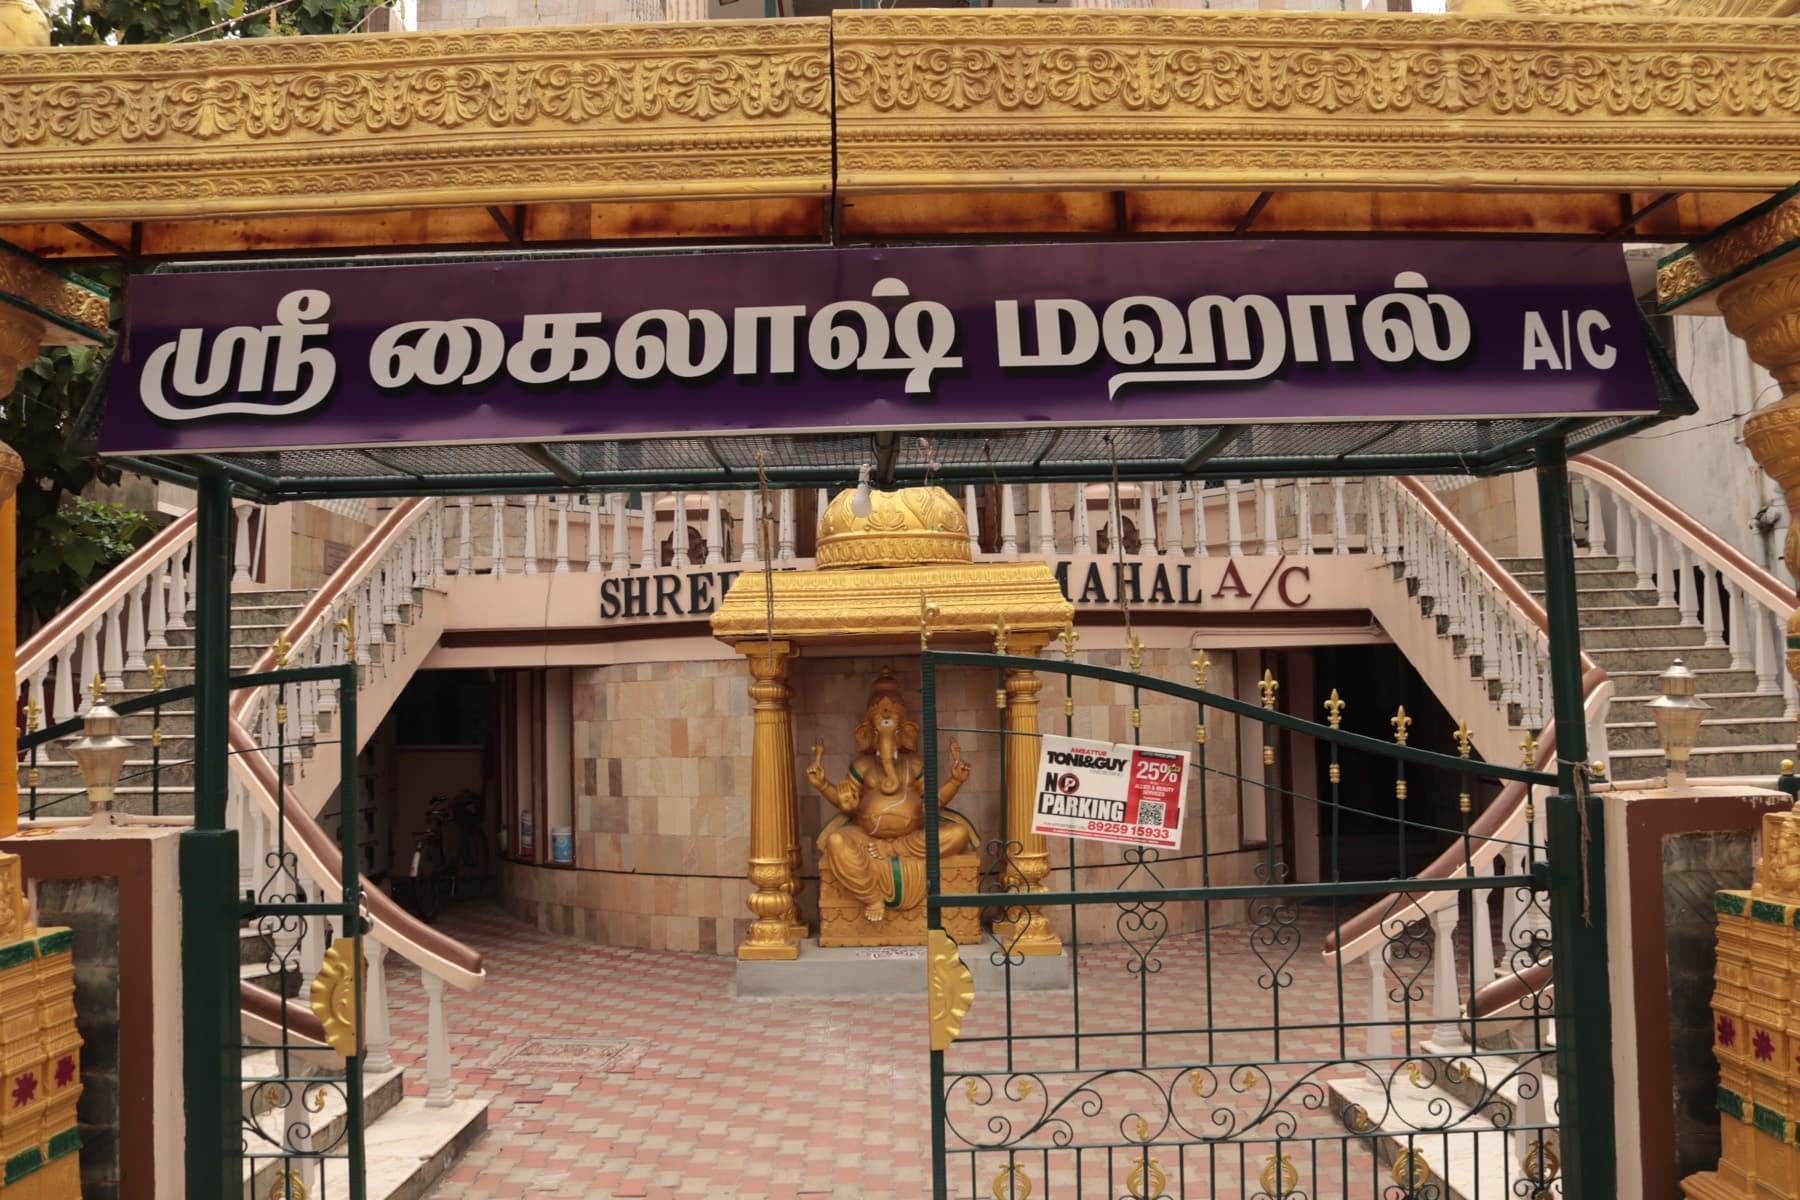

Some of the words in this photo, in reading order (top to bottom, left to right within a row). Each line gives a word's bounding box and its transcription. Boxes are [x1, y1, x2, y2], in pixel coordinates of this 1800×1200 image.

[369, 277, 963, 394] கைலாஷ்
[996, 271, 1472, 401] மஹால்
[1522, 308, 1617, 370] A/C
[1211, 555, 1311, 609] A/C
[1047, 751, 1128, 772] TONI&GUY
[1135, 760, 1178, 783] 25%
[1041, 793, 1125, 822] PARKING
[1087, 820, 1128, 834] 89259
[1131, 826, 1169, 839] 15933
